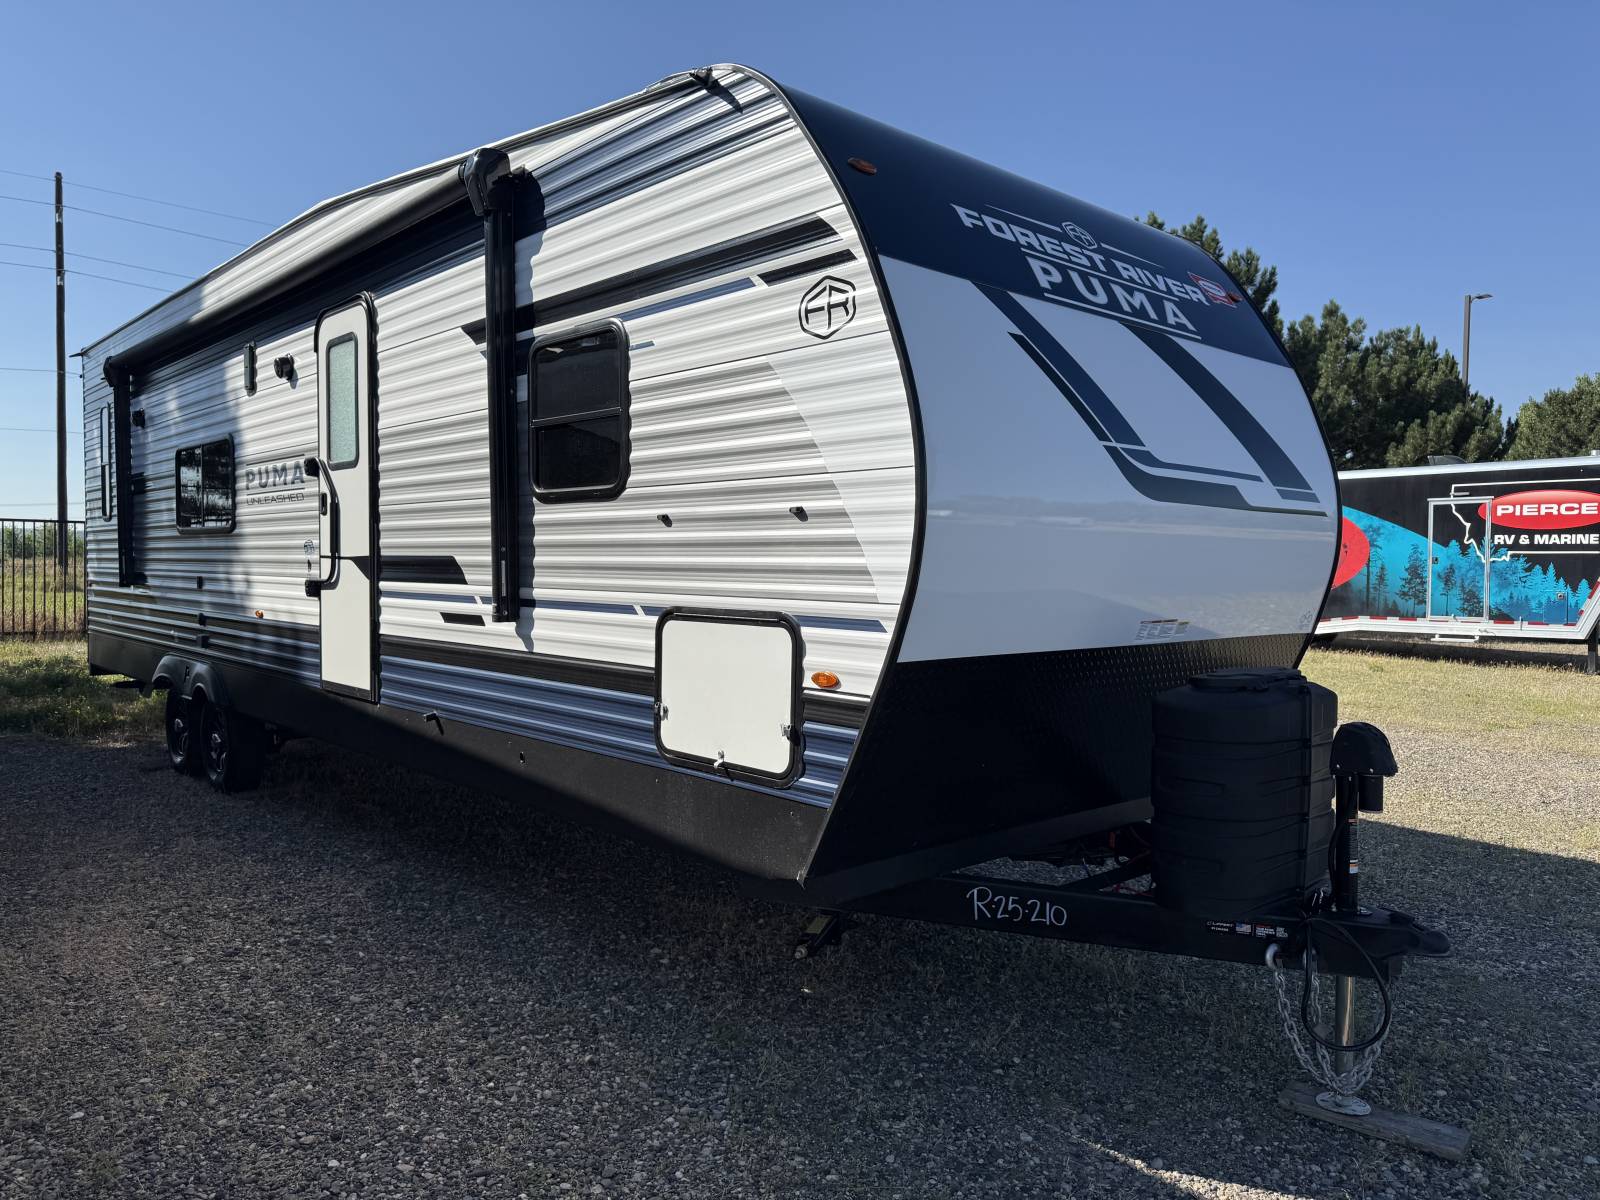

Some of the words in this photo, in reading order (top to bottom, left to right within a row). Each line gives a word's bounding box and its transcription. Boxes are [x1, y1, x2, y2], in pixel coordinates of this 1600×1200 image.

[949, 203, 1106, 273] FOREST
[1110, 258, 1210, 306] RIVER
[1024, 255, 1197, 332] PUMA
[245, 460, 306, 490] PUMA
[246, 492, 305, 506] UNLEASHED
[1496, 502, 1599, 517] PIERCE
[1493, 534, 1515, 546] RV
[1518, 534, 1530, 545] &
[1534, 533, 1600, 545] MARINE
